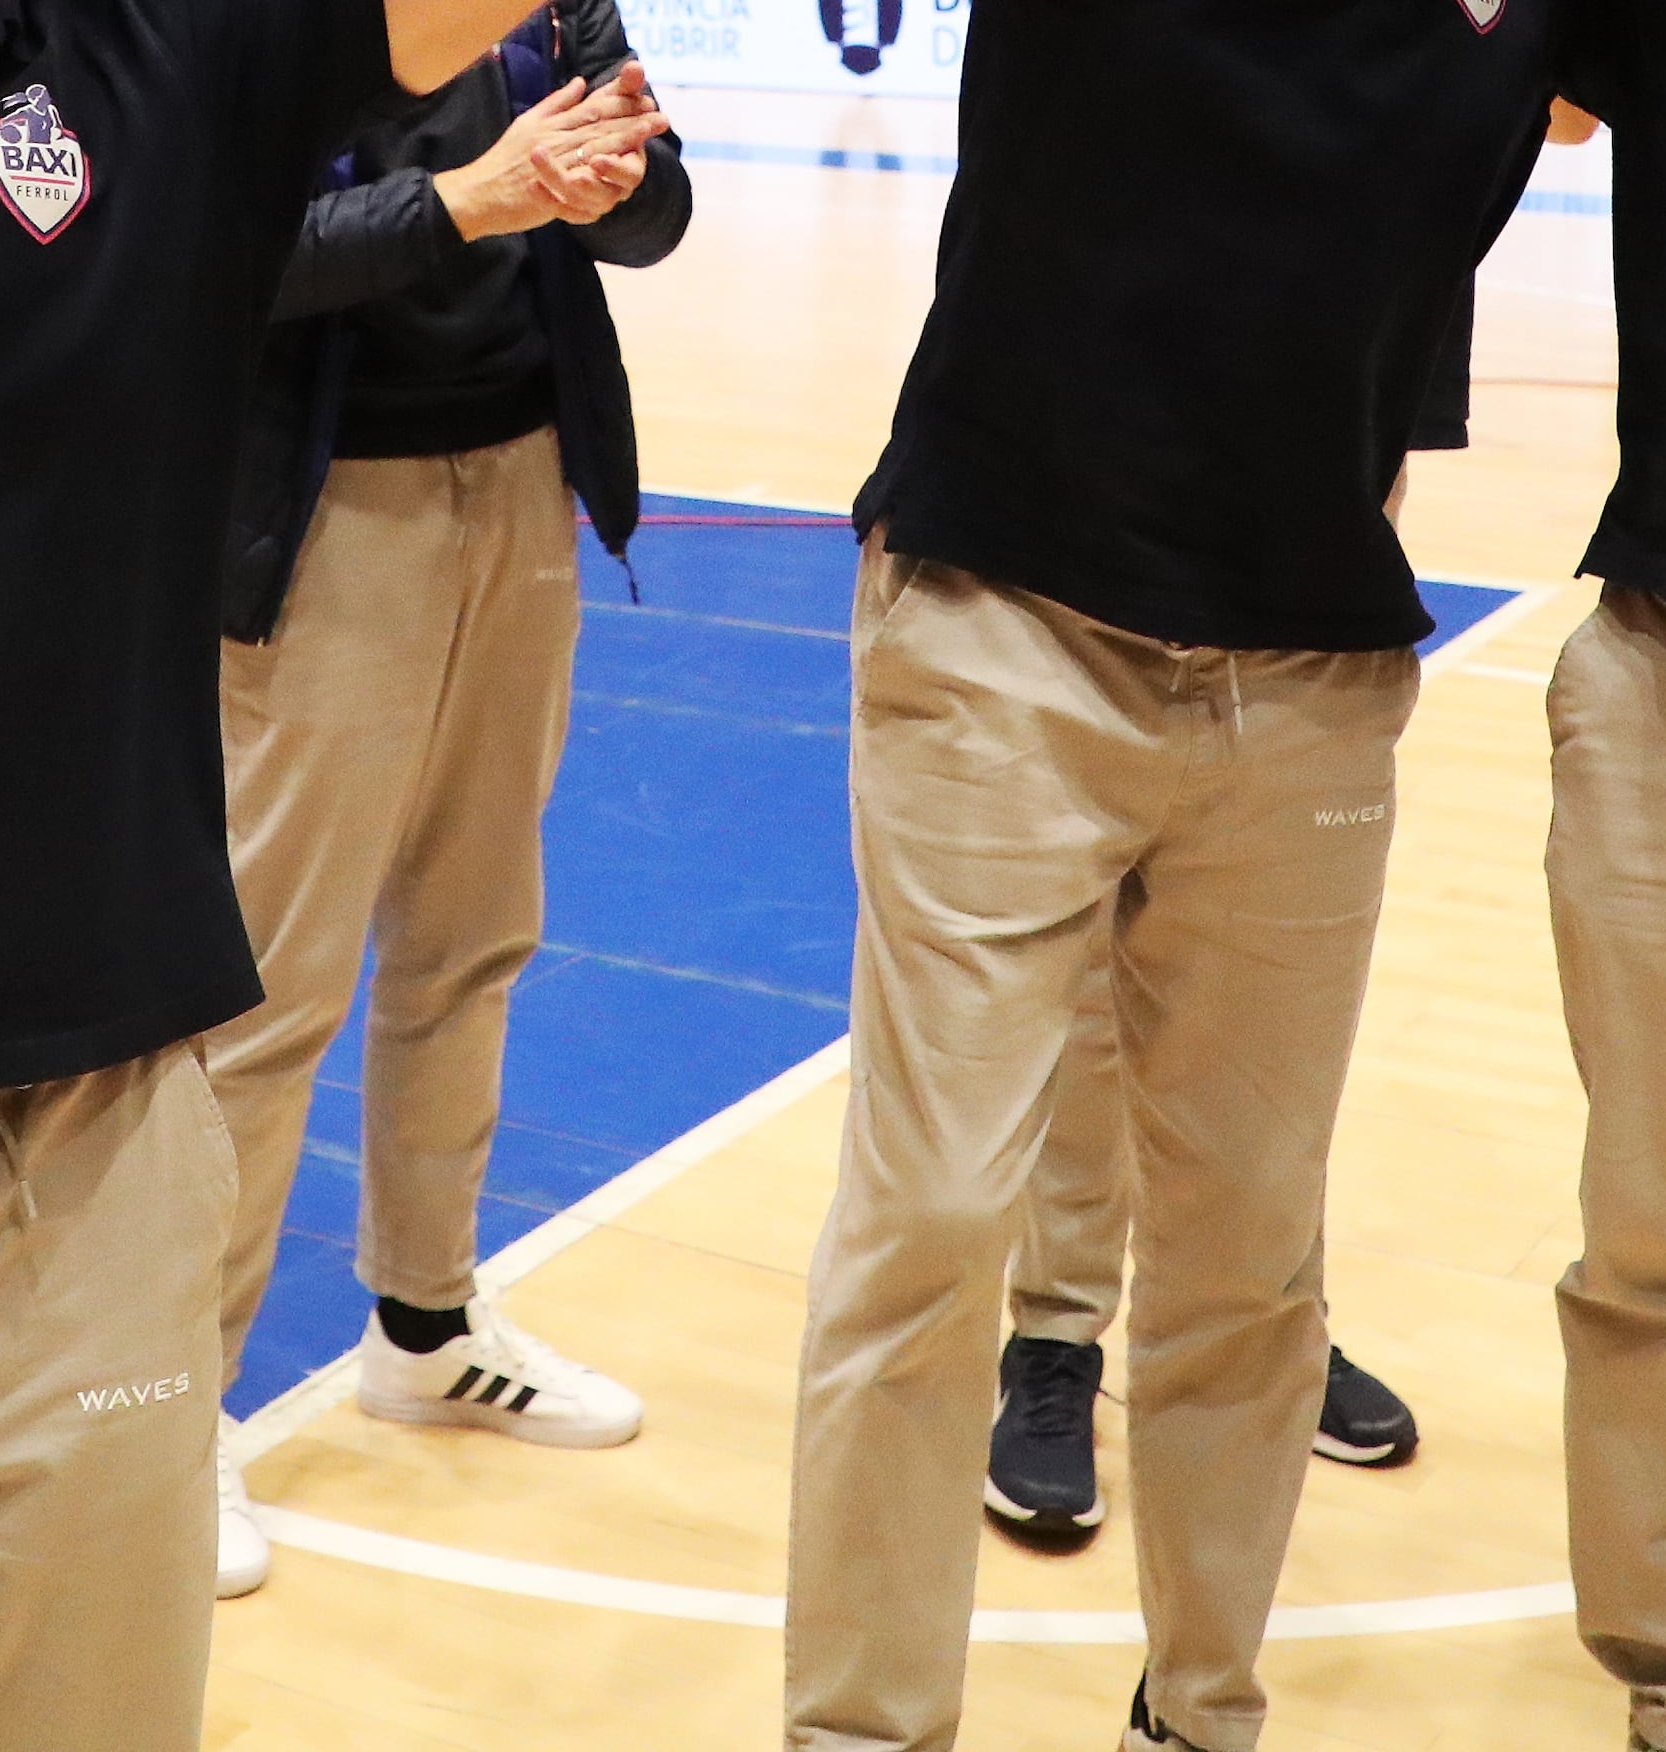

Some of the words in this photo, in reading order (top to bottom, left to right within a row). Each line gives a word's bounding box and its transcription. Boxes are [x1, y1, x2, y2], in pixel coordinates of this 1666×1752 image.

[0, 145, 77, 178] BAXI
[16, 185, 70, 202] FERROL
[1314, 803, 1386, 827] WAVES
[76, 1371, 191, 1413] WAVES
